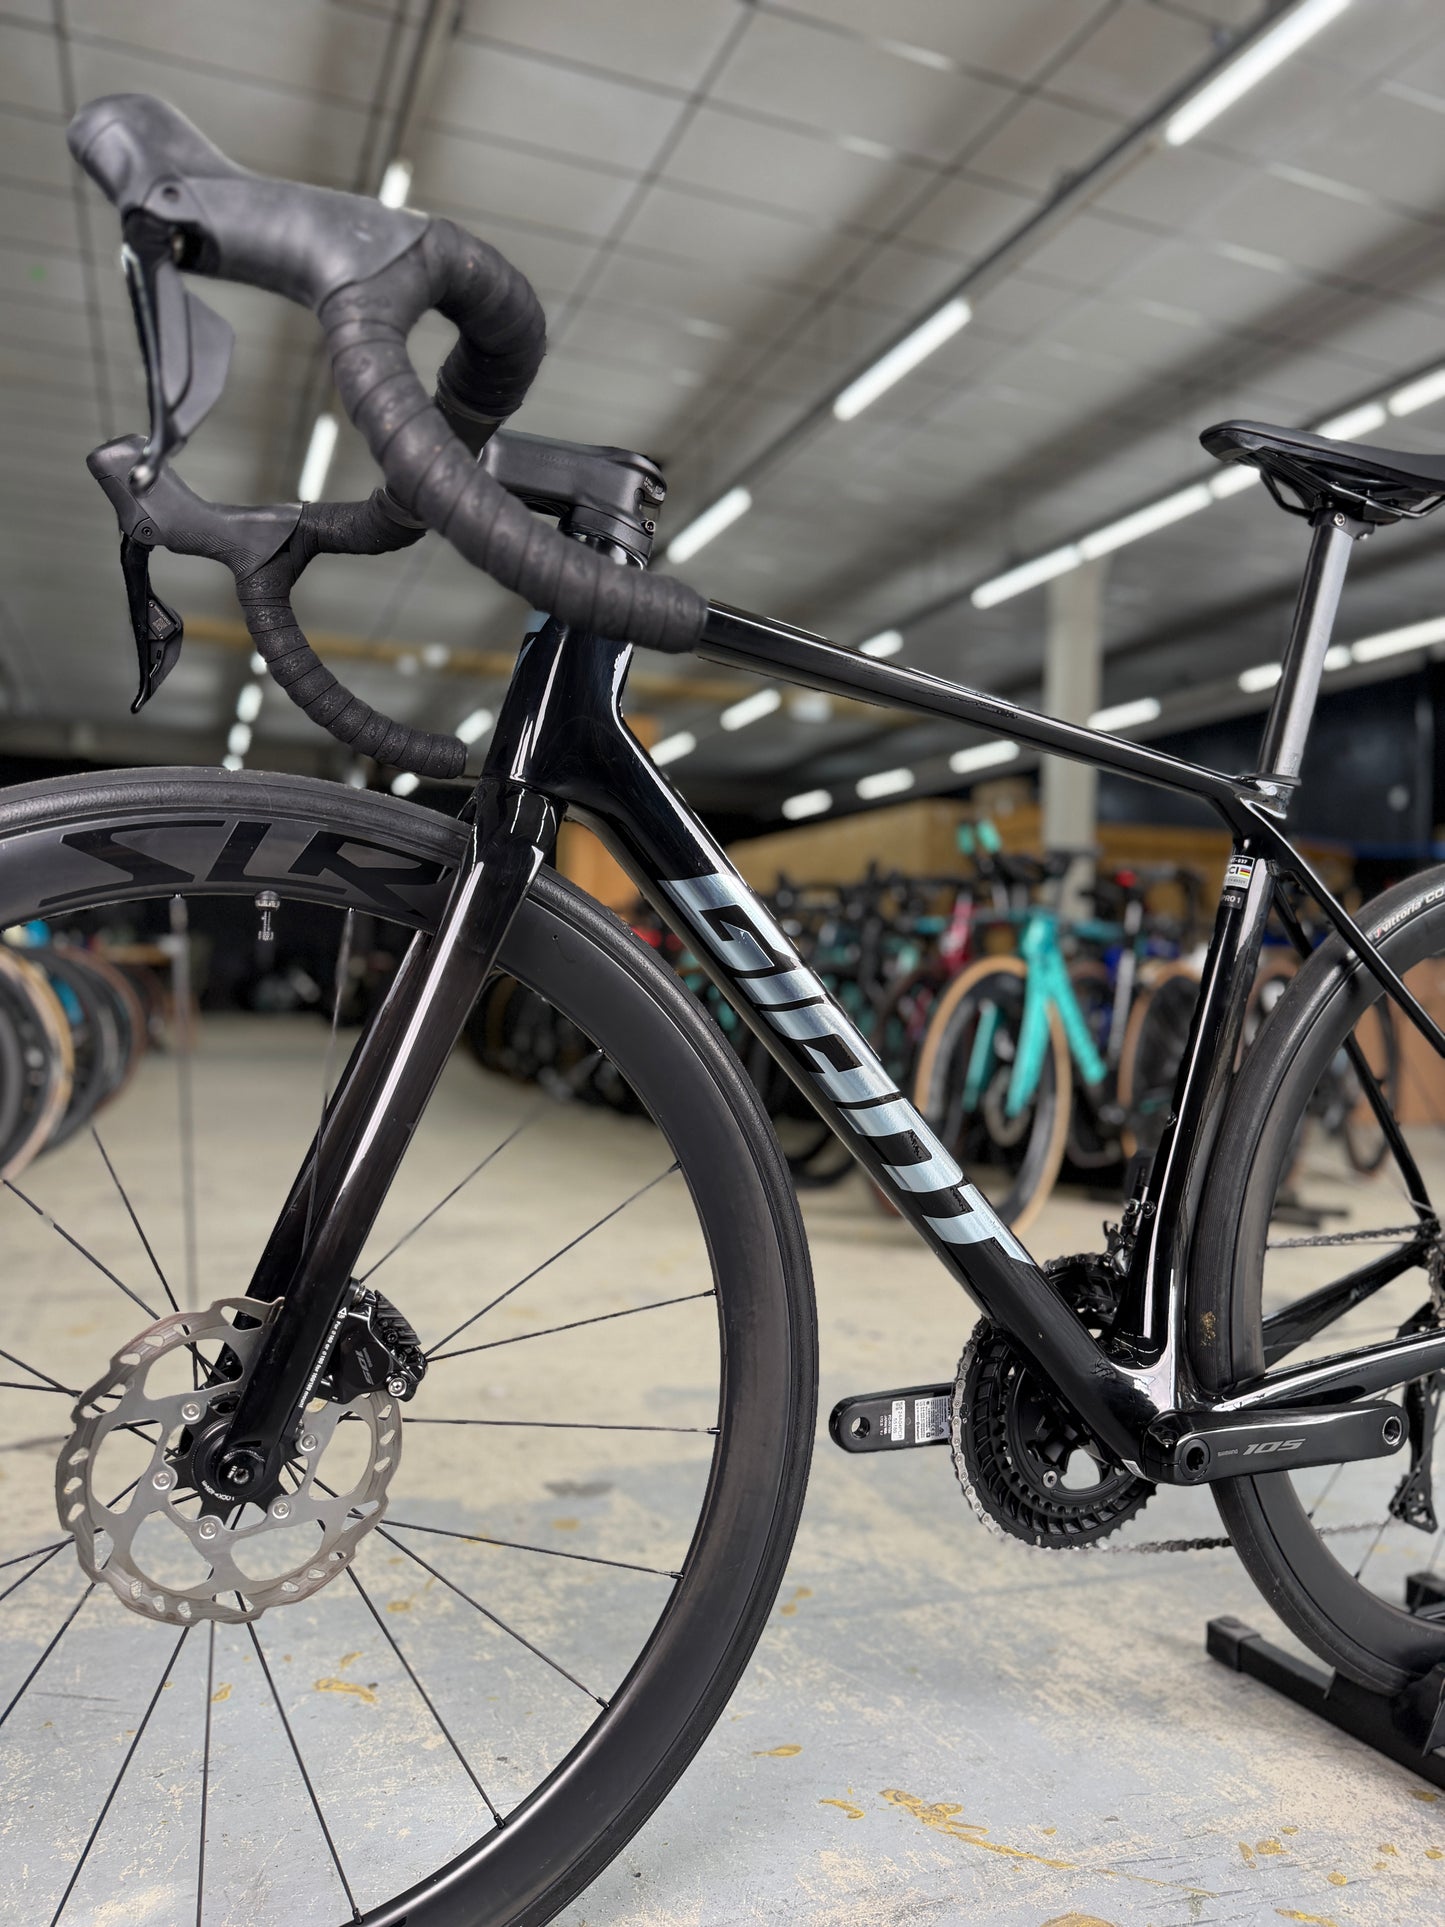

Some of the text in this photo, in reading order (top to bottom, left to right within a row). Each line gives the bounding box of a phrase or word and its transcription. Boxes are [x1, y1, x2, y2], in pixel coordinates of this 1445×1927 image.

[39, 820, 446, 919] SLR
[657, 872, 1036, 1266] GIANT
[1242, 1438, 1306, 1456] 105
